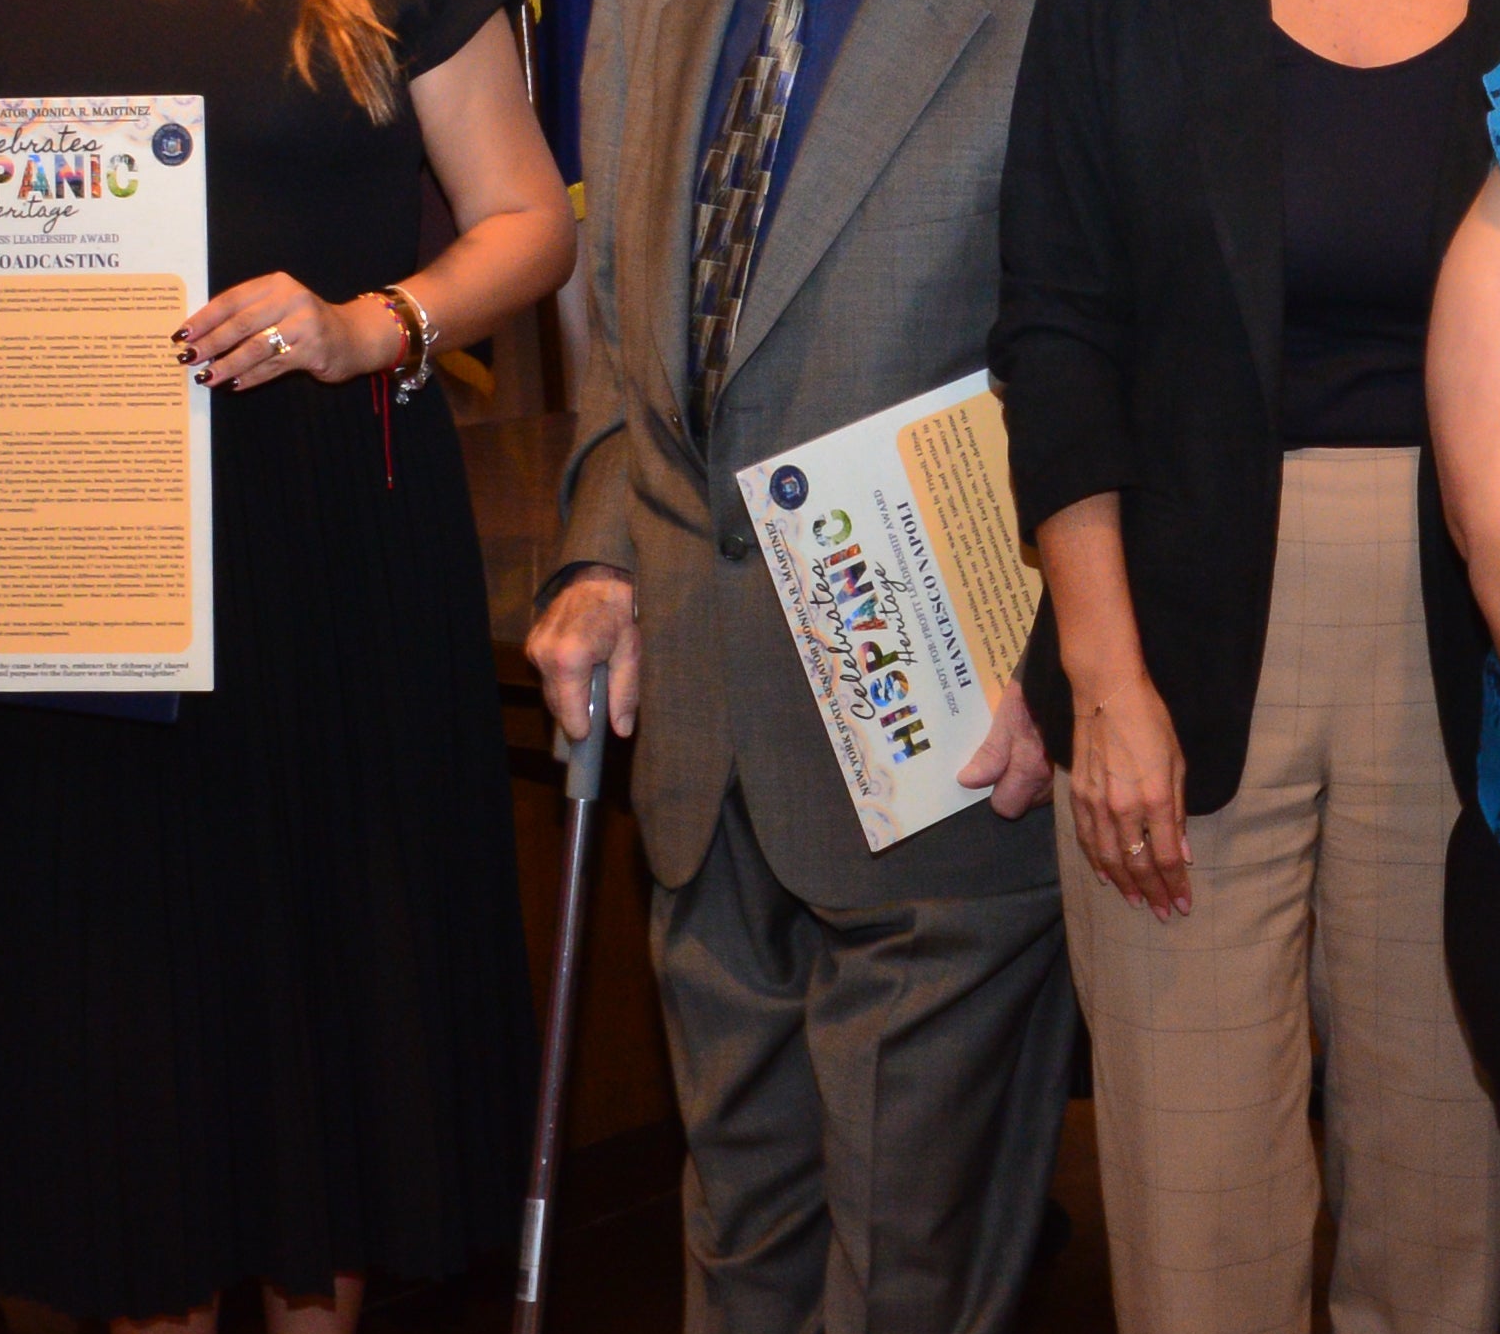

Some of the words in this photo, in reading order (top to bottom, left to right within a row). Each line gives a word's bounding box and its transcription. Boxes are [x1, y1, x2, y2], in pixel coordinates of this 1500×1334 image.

[29, 107, 77, 118] MONICA
[92, 105, 151, 117] MARTINEZ
[763, 518, 794, 582] MARTINEZ
[895, 499, 932, 574] NAPOLI
[790, 593, 817, 647] MONICA
[809, 559, 876, 720] Celebrates
[812, 509, 931, 763] HISPANIC
[875, 564, 918, 665] Heritage
[921, 572, 972, 689] FRANCESCO
[808, 644, 836, 699] SENATOR
[827, 697, 848, 734] STATE
[840, 733, 860, 767] YORK
[852, 765, 871, 796] NEW
